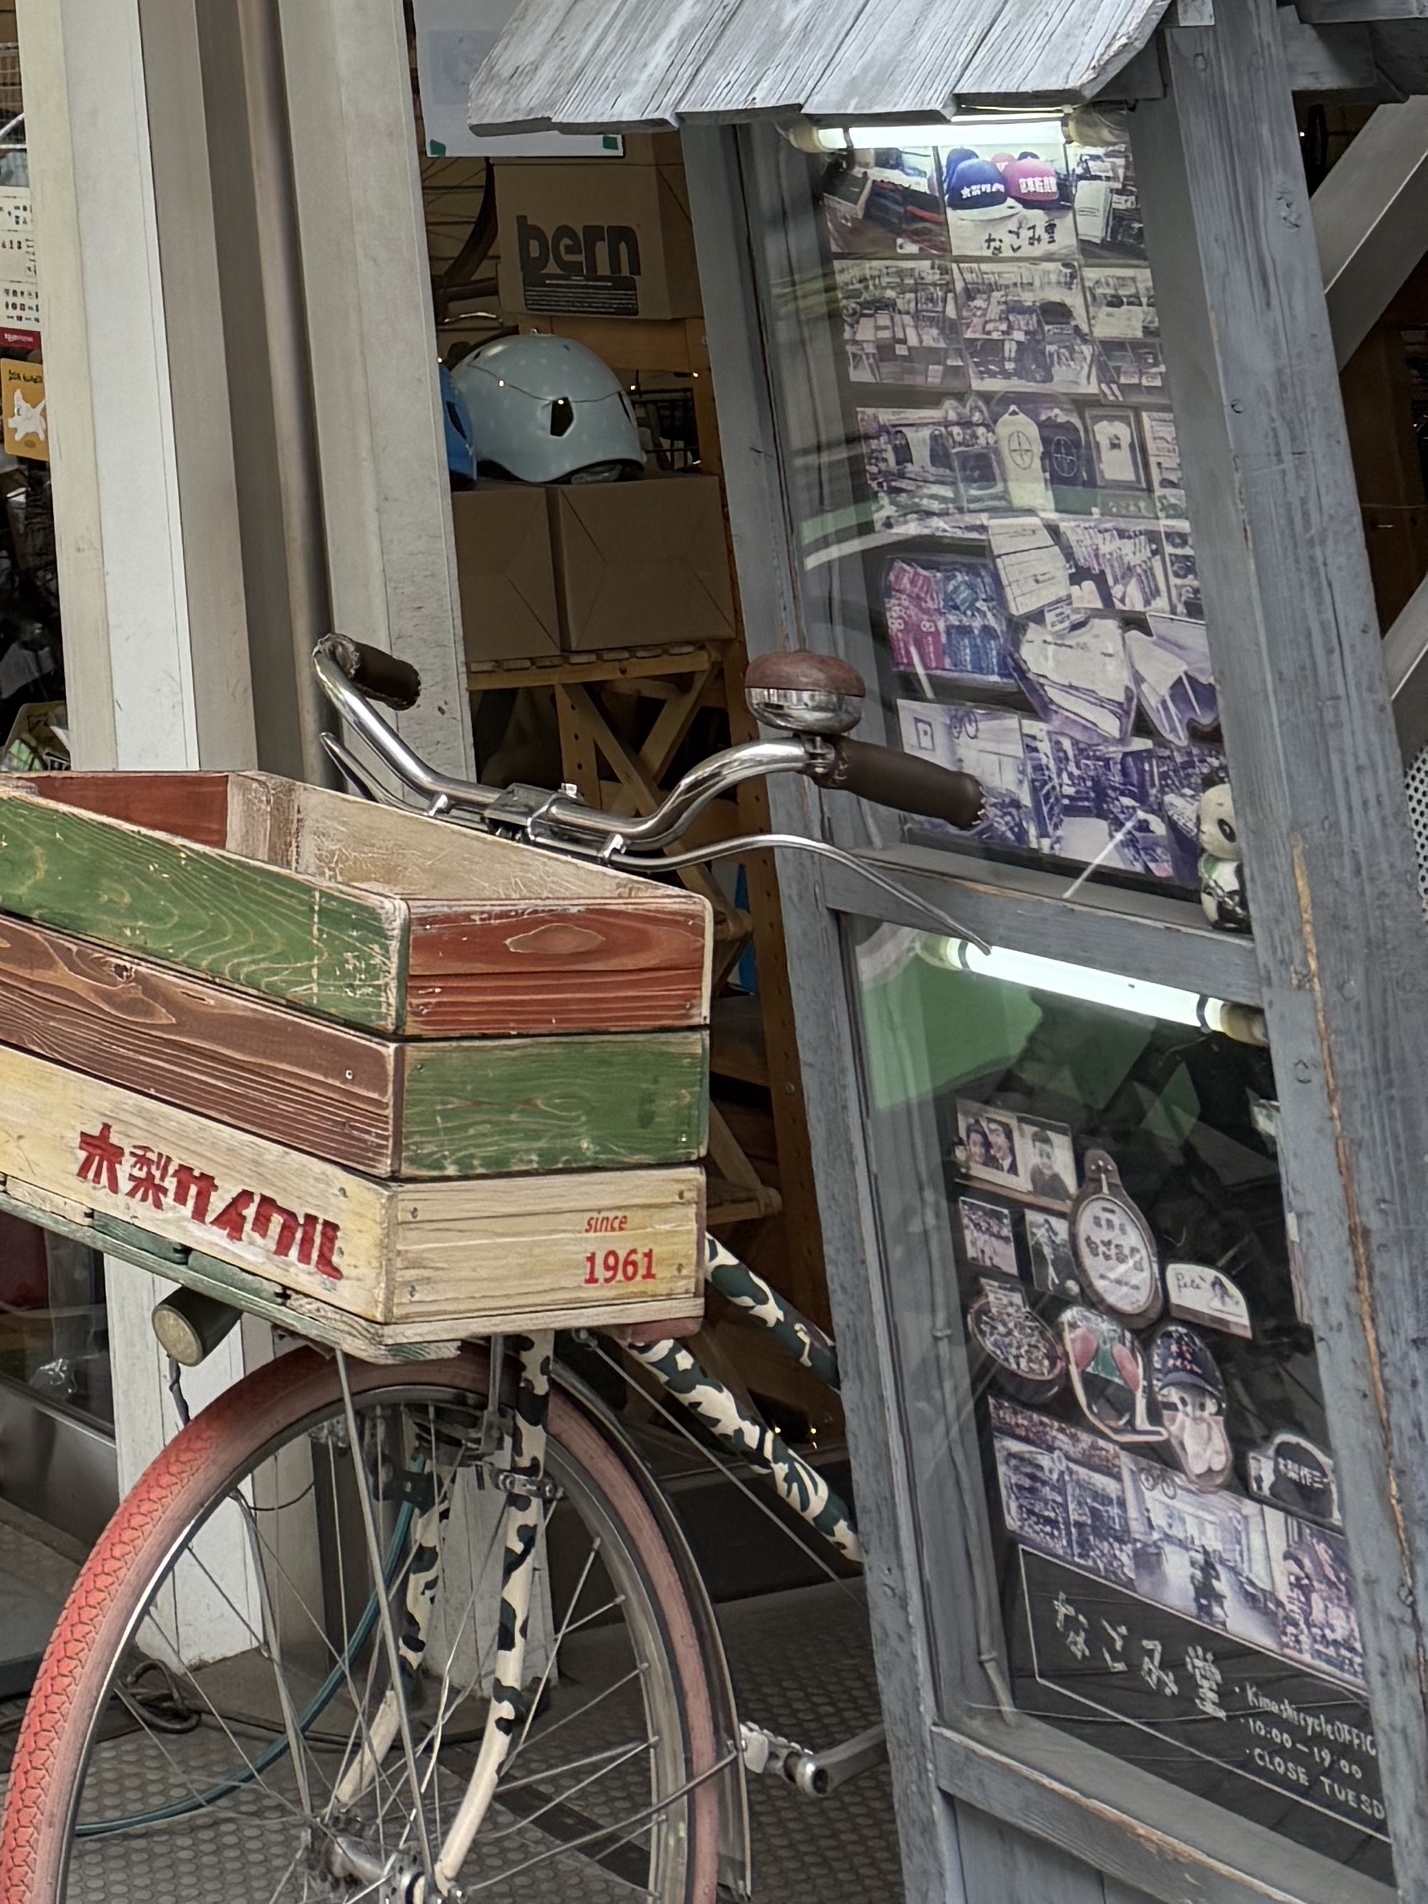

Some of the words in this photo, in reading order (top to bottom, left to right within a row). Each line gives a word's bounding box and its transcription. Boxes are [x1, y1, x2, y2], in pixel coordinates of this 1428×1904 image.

[516, 215, 641, 276] bern
[76, 1122, 343, 1281] 木梨サイクル
[585, 1211, 627, 1233] since
[584, 1248, 656, 1285] 1961
[1053, 1591, 1227, 1722] なごみ堂
[1254, 1748, 1309, 1786] CLOSE
